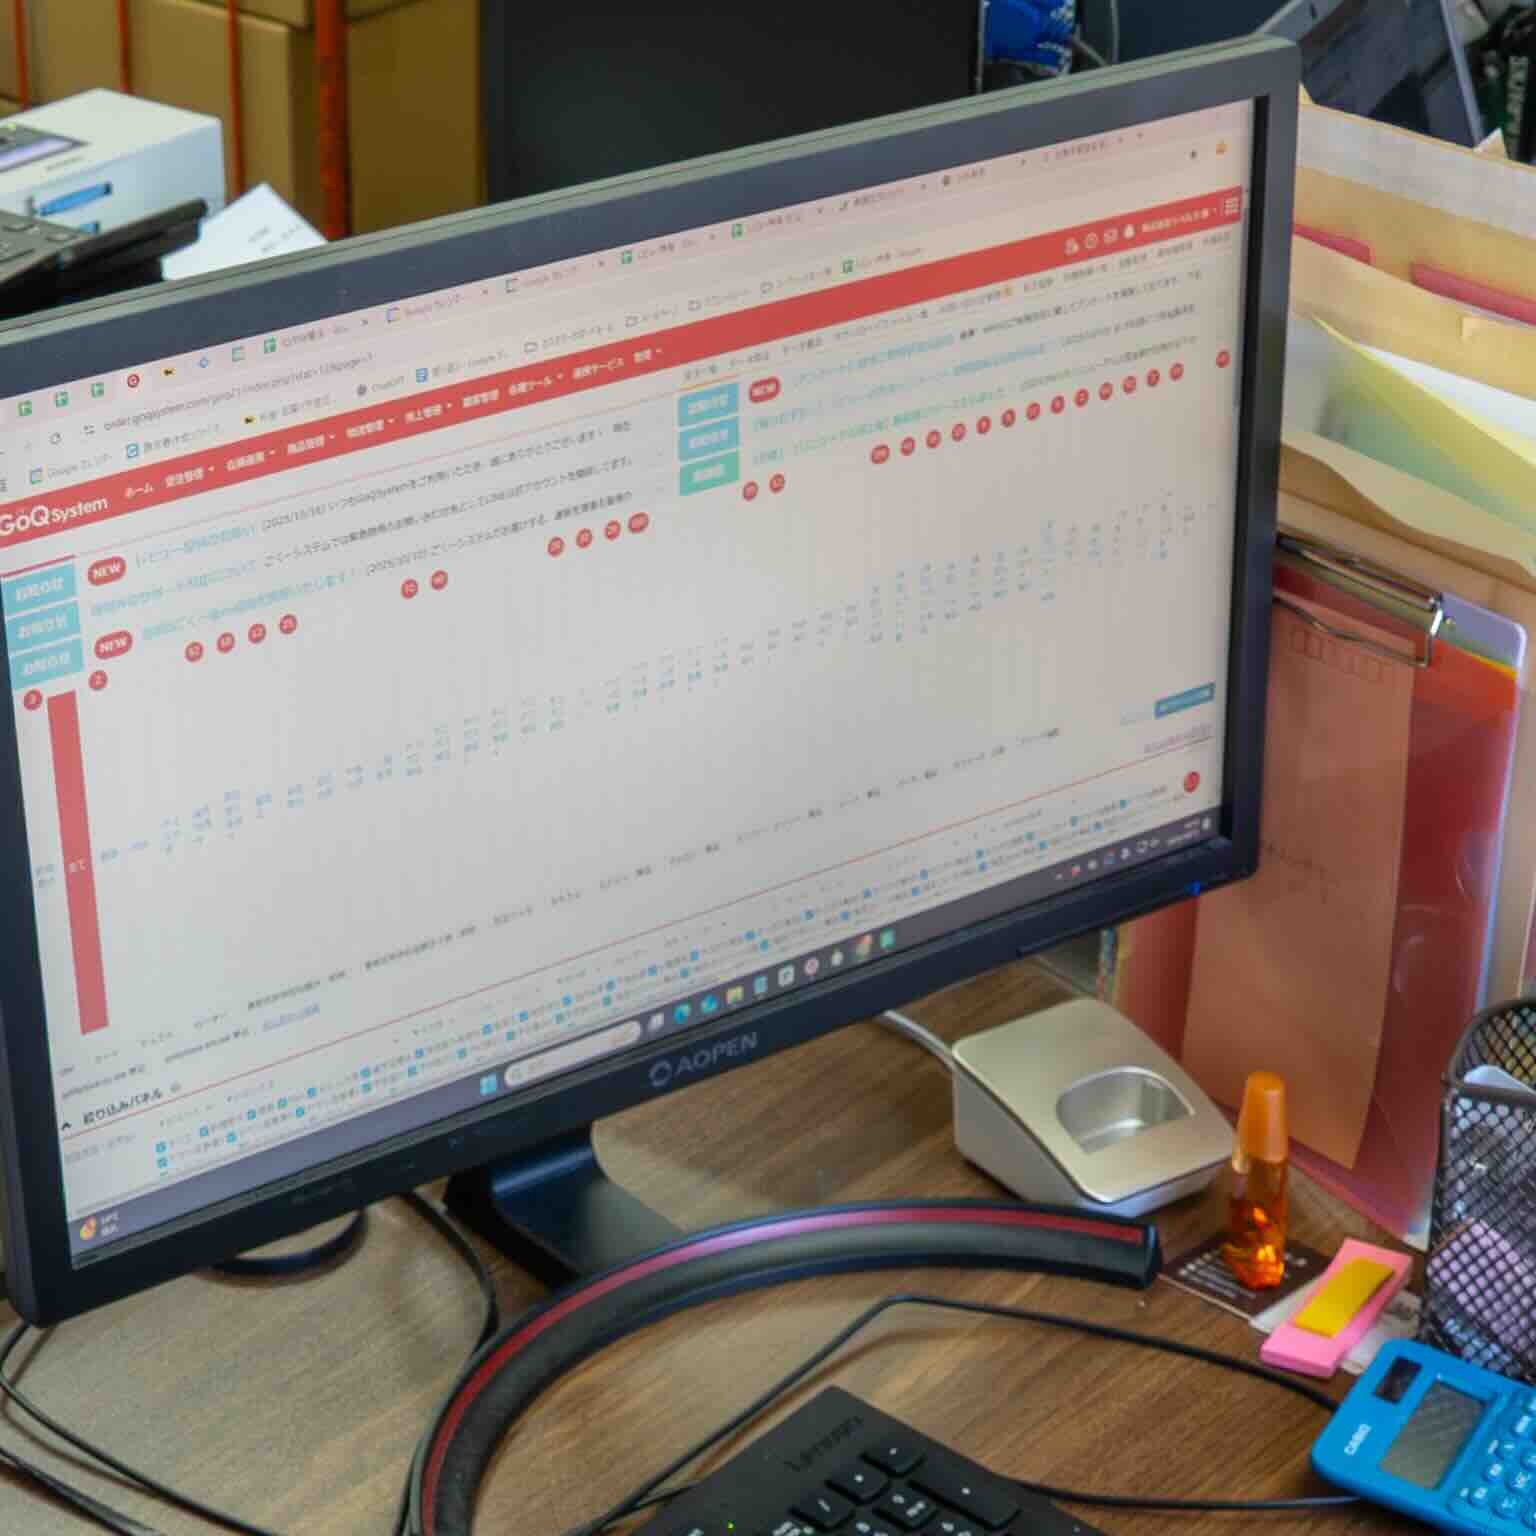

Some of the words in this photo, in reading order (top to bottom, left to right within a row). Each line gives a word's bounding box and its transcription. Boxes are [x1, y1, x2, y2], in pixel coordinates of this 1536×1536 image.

[125, 481, 153, 497] ホーム
[92, 562, 121, 579] NEW
[99, 636, 128, 654] NEW
[677, 1032, 758, 1074] AOPEN
